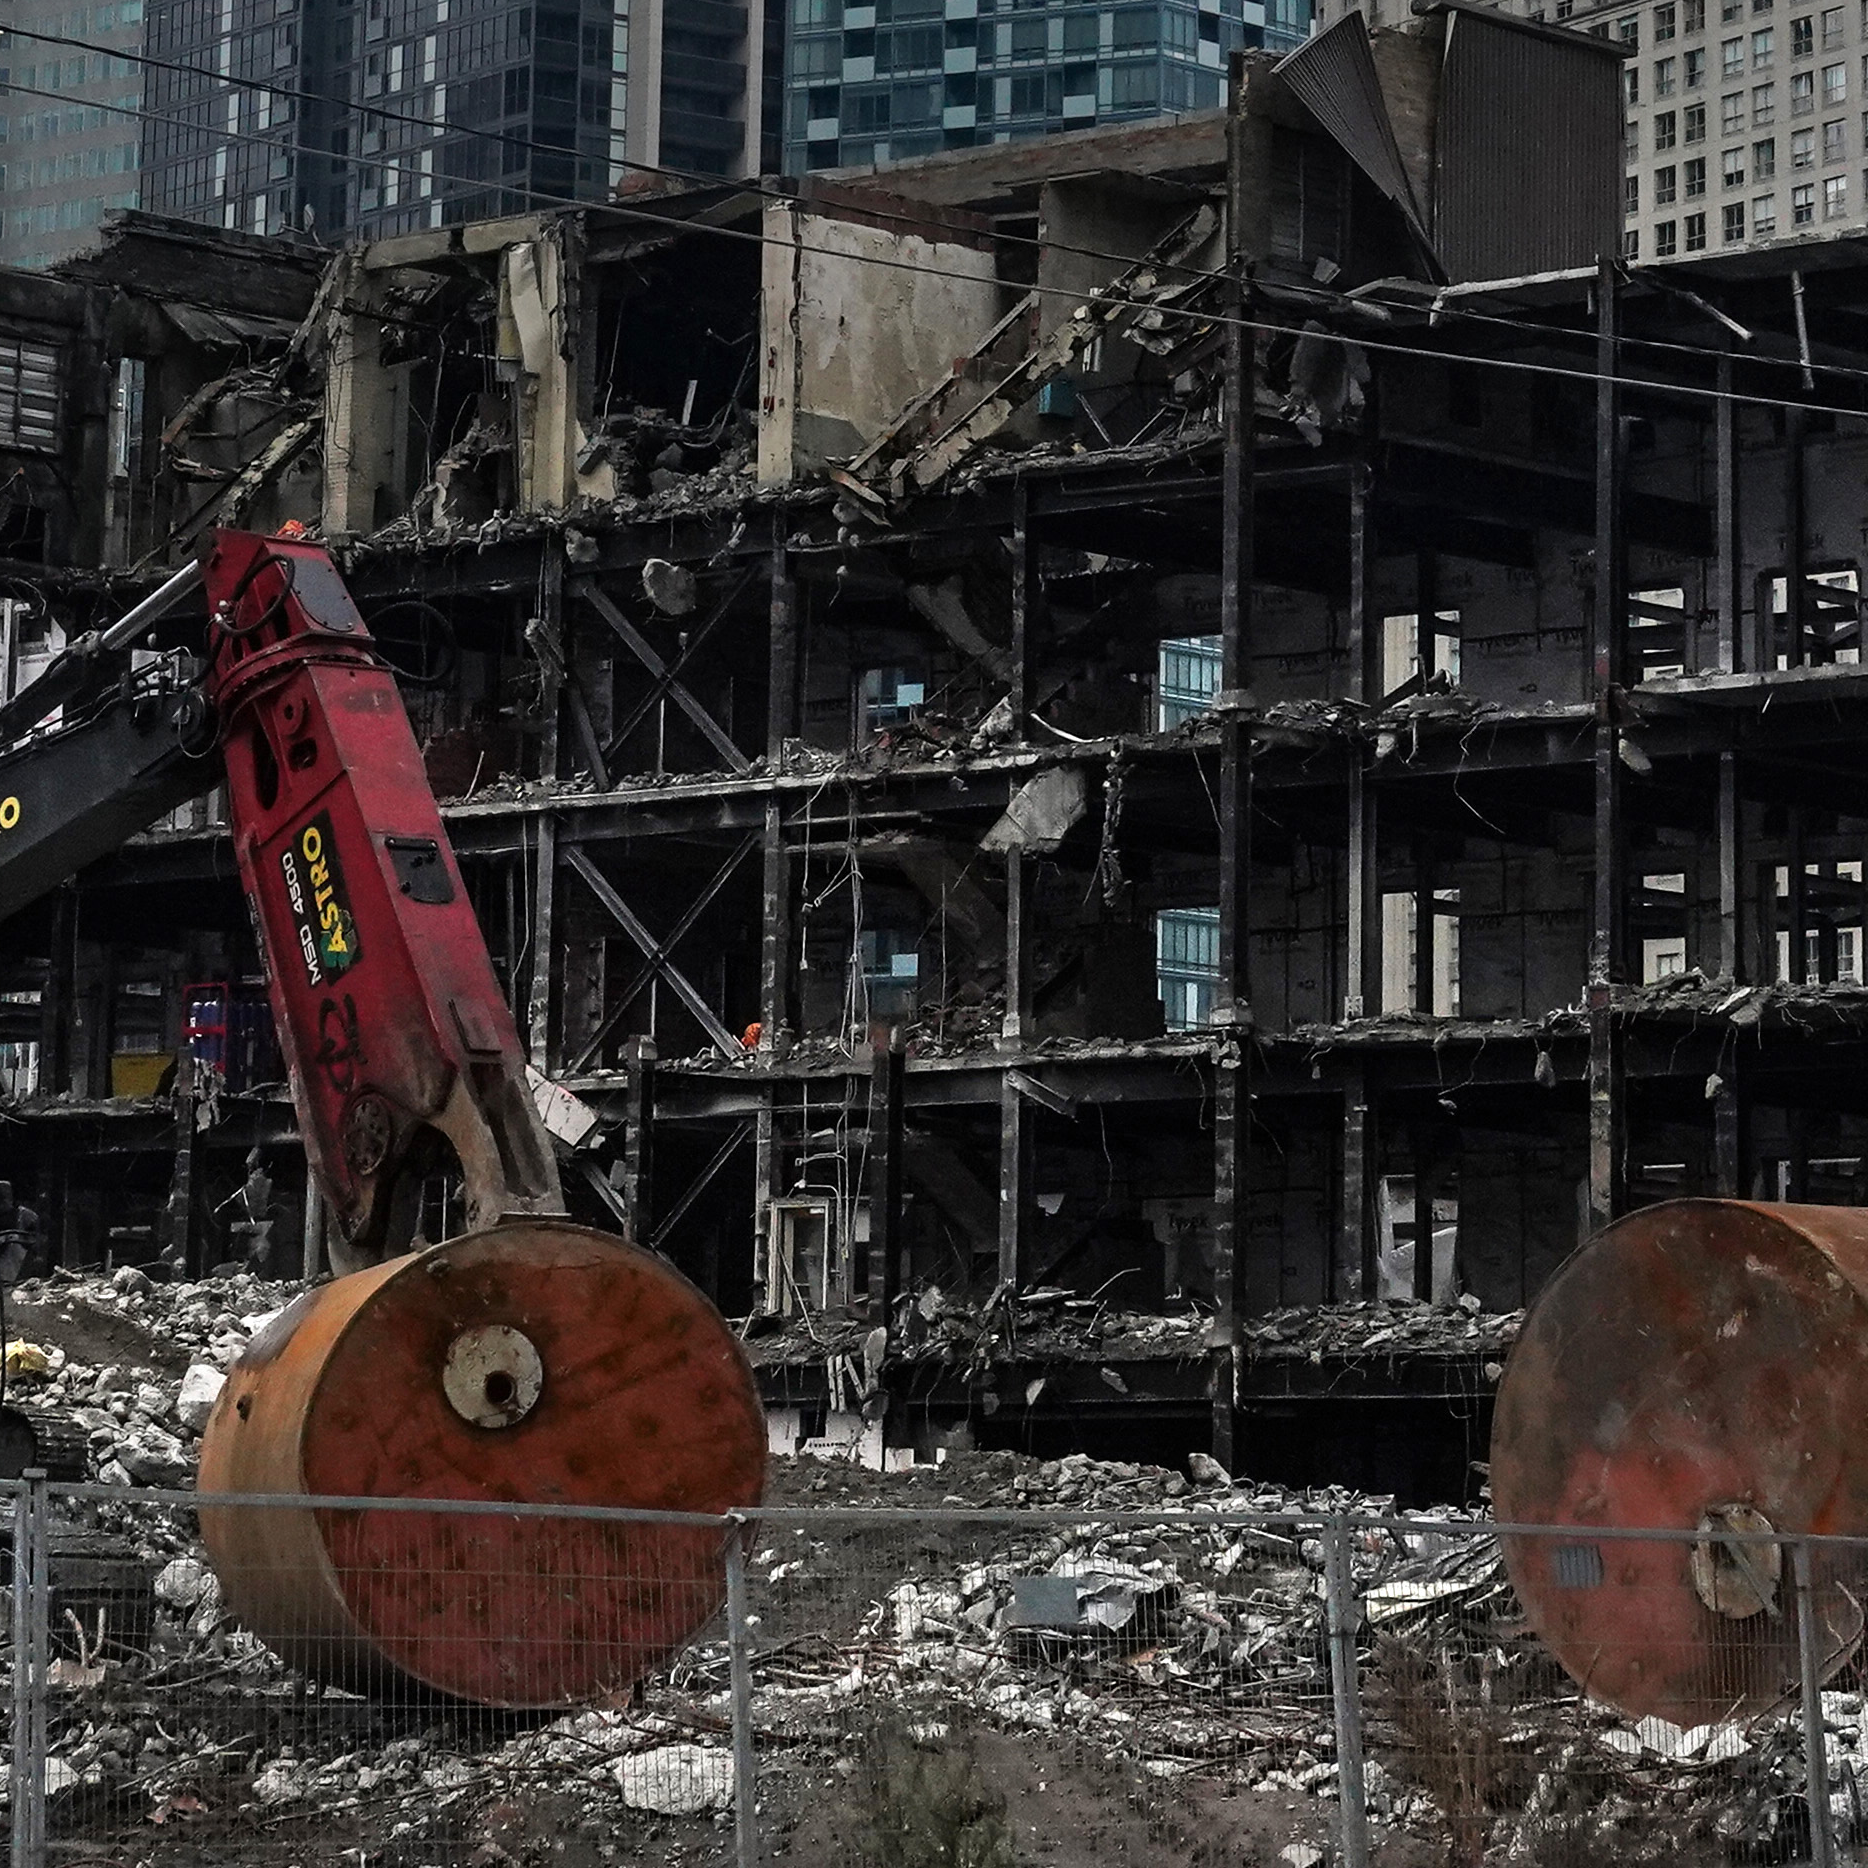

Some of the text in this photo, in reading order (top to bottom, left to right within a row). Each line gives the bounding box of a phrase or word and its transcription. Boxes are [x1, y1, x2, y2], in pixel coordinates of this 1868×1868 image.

[282, 851, 322, 986] MSD 4500
[302, 826, 348, 953] ASTRO
